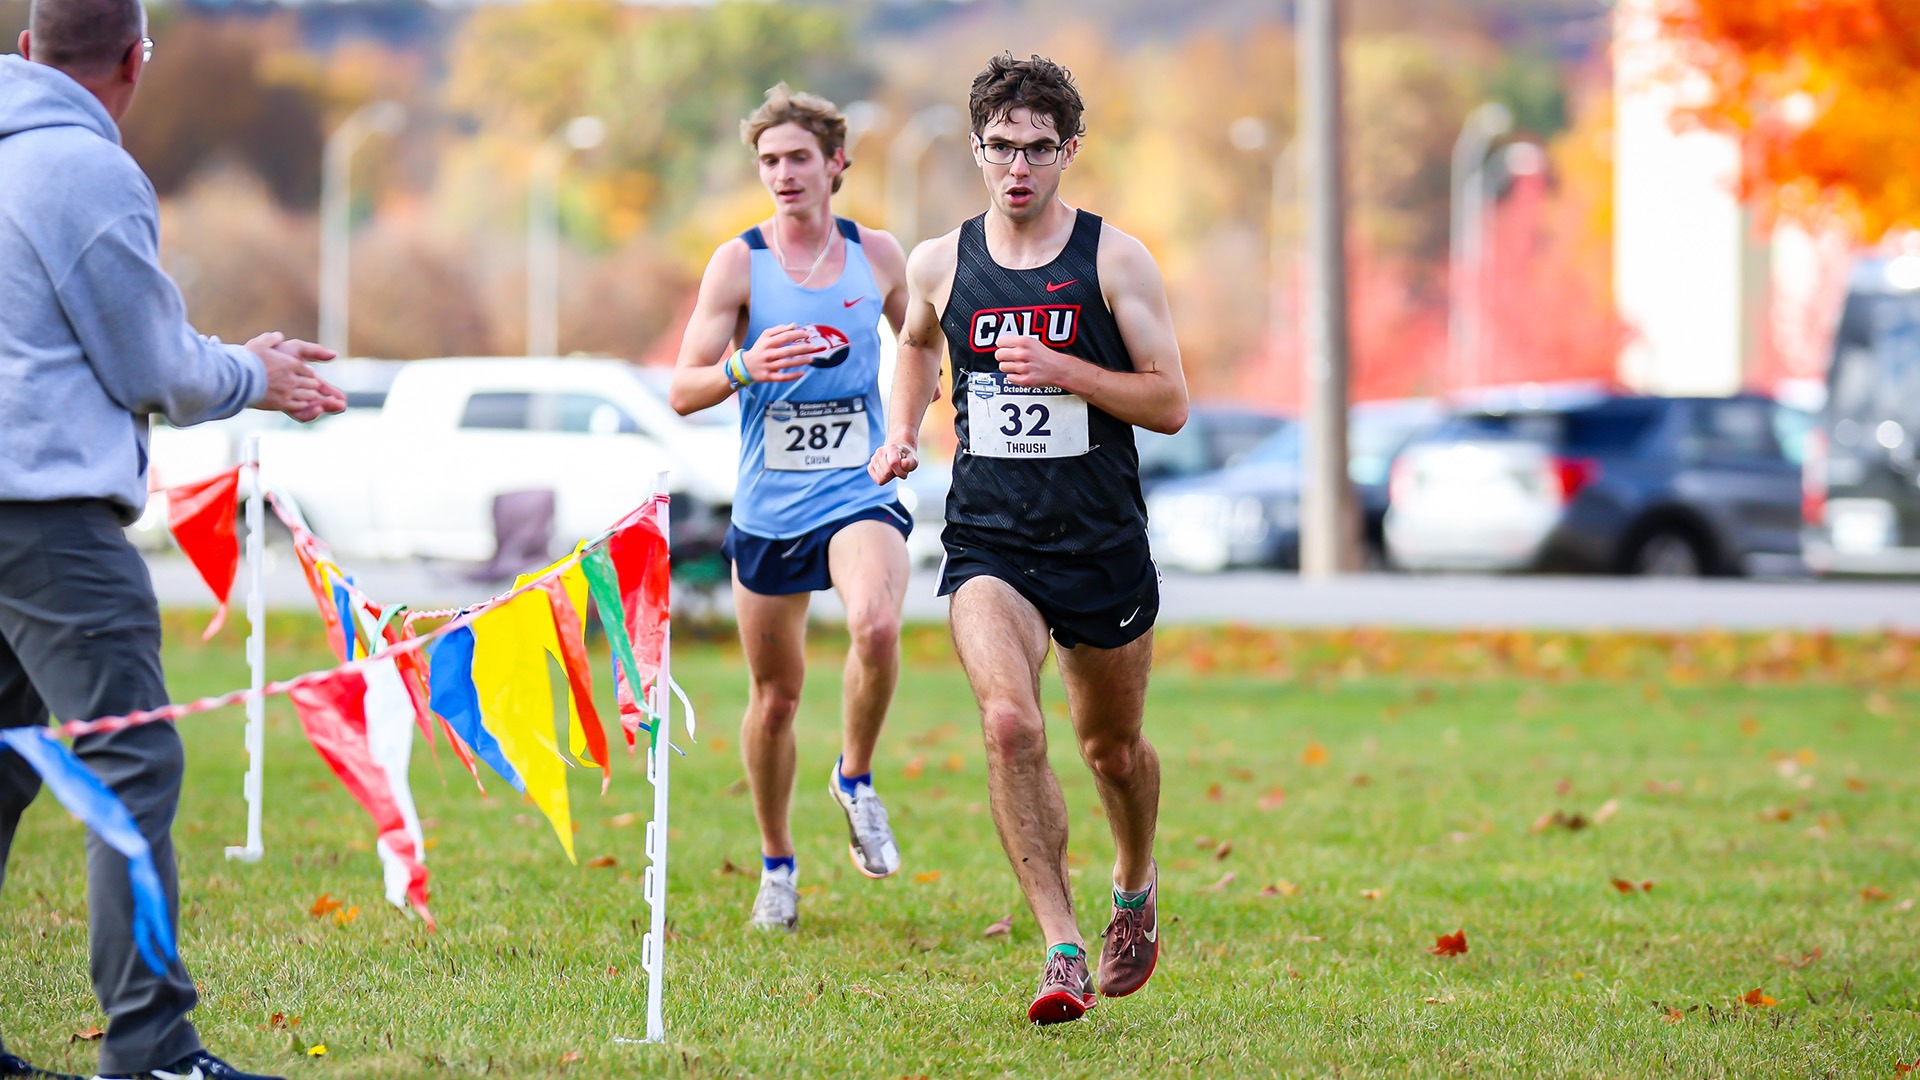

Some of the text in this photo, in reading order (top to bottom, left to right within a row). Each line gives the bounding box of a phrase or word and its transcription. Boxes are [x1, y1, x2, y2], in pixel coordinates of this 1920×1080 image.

[1003, 386, 1031, 394] October
[999, 403, 1052, 437] 32
[785, 421, 852, 451] 287
